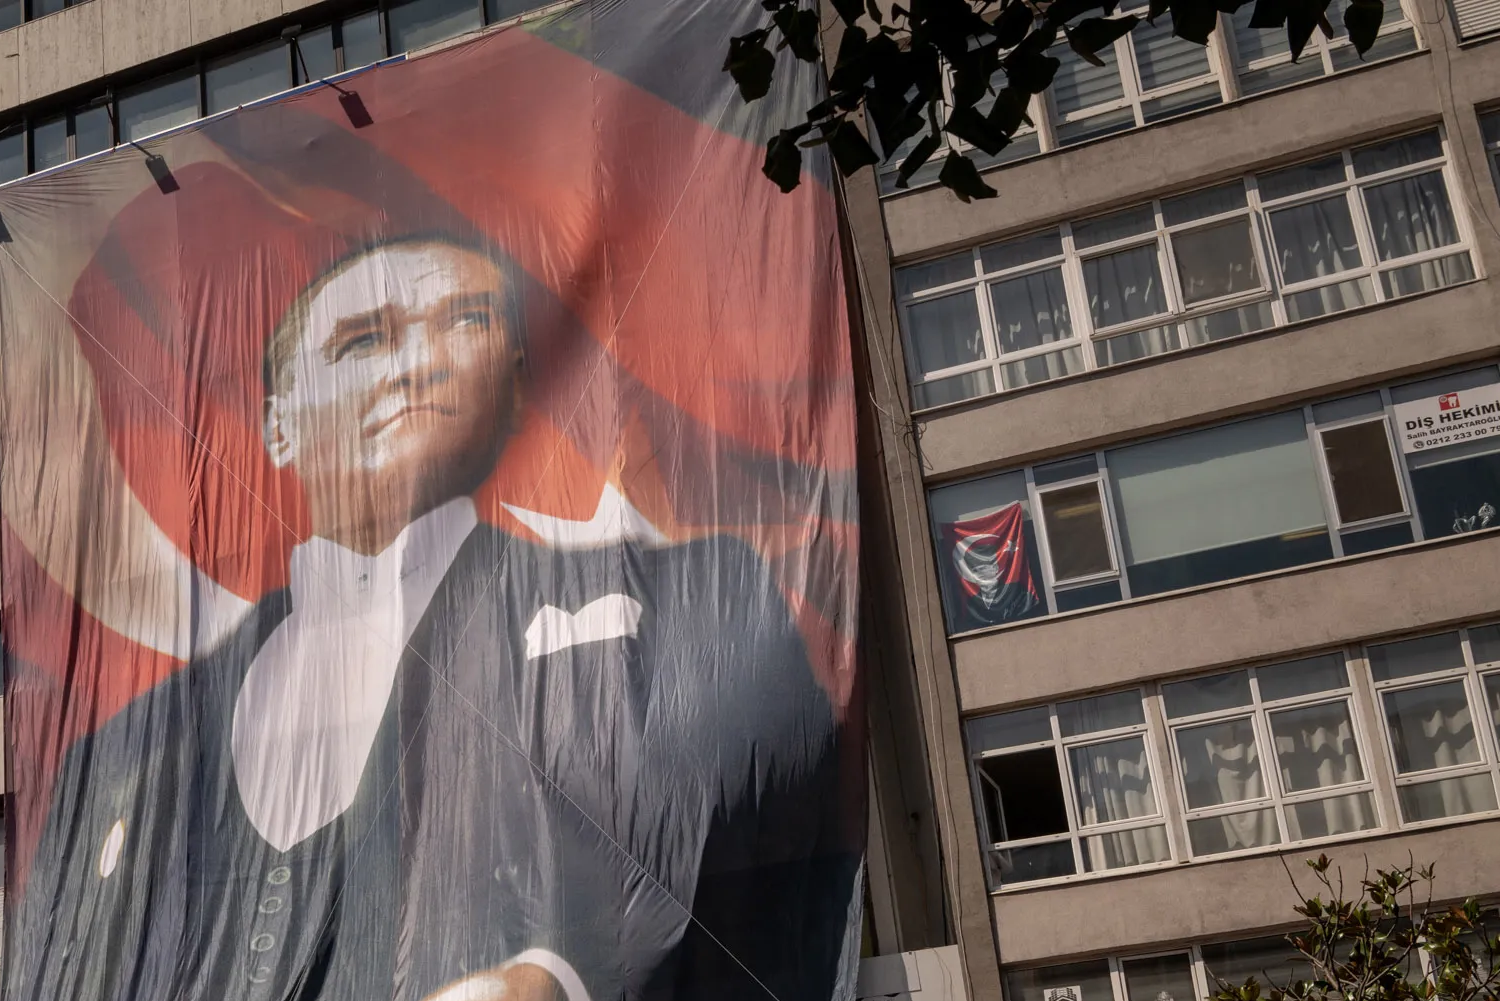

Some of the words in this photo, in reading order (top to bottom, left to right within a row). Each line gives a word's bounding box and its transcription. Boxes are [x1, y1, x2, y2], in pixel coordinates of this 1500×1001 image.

[1405, 416, 1434, 430] DİŞ
[1407, 432, 1428, 440] Salih
[1426, 436, 1451, 446] 0212
[1454, 432, 1473, 441] 233
[1475, 428, 1487, 436] 00
